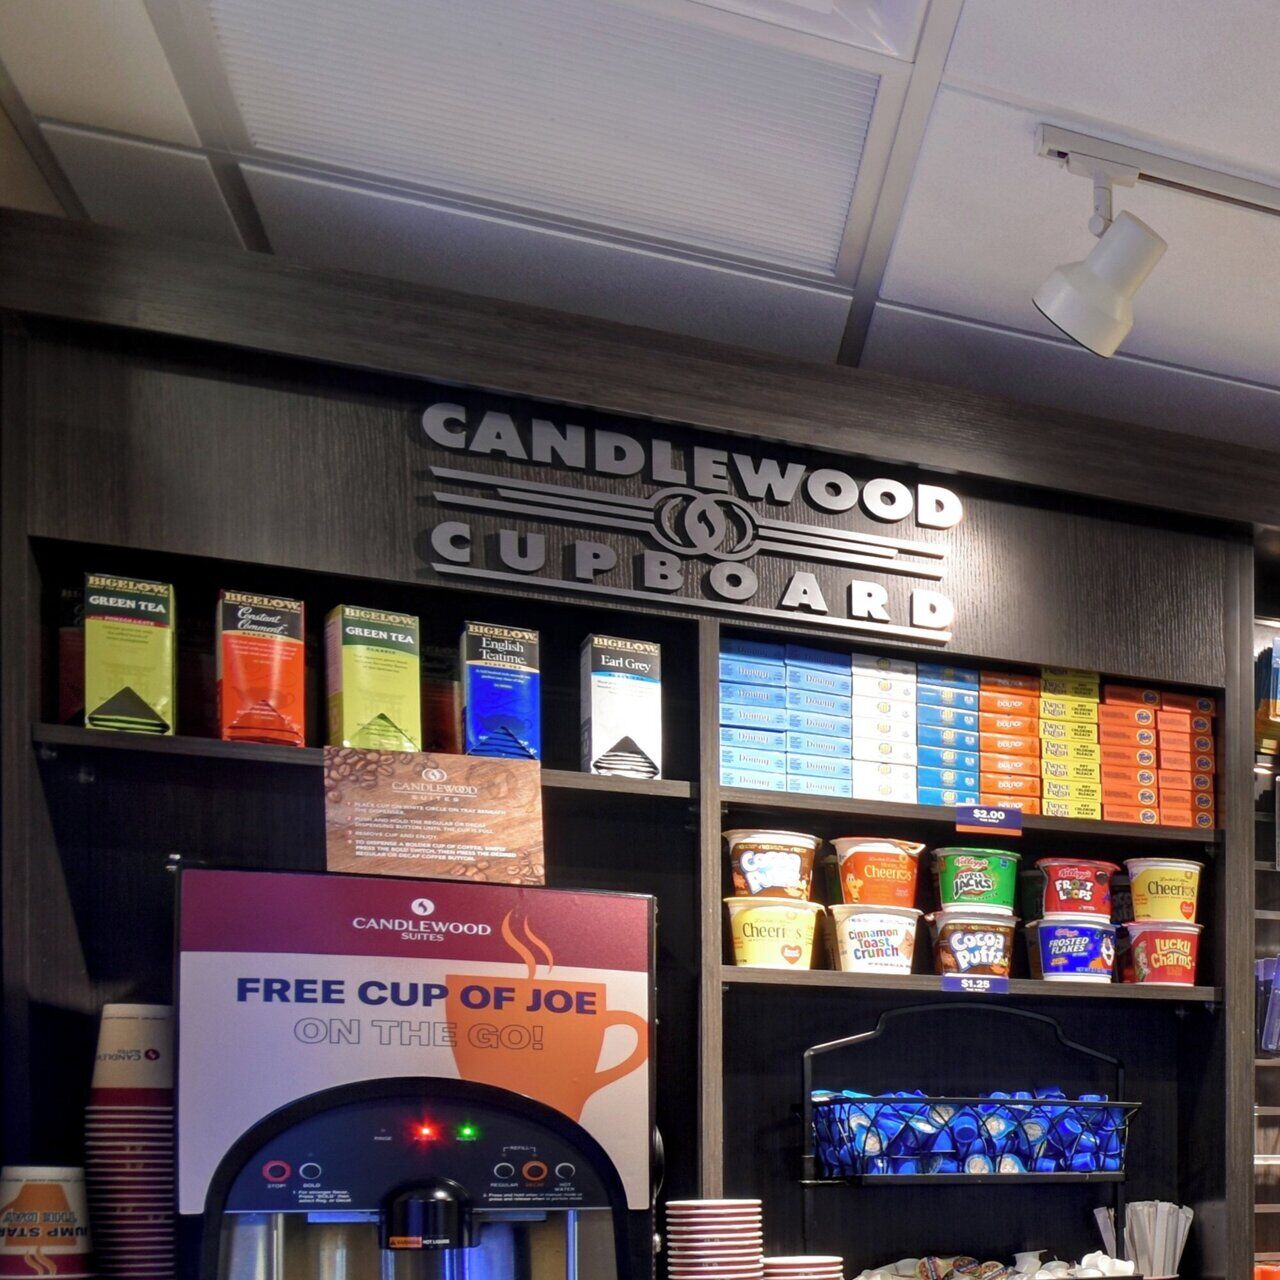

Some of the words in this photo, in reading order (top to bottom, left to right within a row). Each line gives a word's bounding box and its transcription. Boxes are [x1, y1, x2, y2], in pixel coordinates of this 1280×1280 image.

[422, 402, 963, 530] CANDLEWOOD
[430, 521, 955, 629] CUPBOARD
[88, 576, 168, 594] BIGELOW
[89, 595, 136, 609] GREEN
[138, 602, 166, 613] TEA
[224, 592, 301, 609] BIGELOW
[345, 607, 416, 625] BIGELOW
[346, 626, 388, 640] GREEN
[390, 633, 414, 644] TEA
[468, 624, 536, 641] BIGELOW
[482, 638, 524, 653] English
[593, 637, 658, 653] BIGELOW
[479, 649, 524, 664] Teatime
[601, 654, 624, 666] Earl
[626, 659, 651, 672] Grey
[392, 781, 478, 795] CANDLEWOOD
[972, 808, 1005, 821] $2.00
[954, 856, 988, 868] Kellogg's
[864, 864, 912, 882] Cheerios
[959, 871, 984, 880] APPLE
[1058, 867, 1092, 880] Kellogg's
[953, 877, 992, 899] JACKS
[1054, 880, 1094, 891] FROOT
[1147, 880, 1195, 897] Cheerios
[1058, 889, 1093, 901] LOOPS
[352, 916, 492, 936] CANDLEWOOD
[742, 922, 802, 939] Cheeris
[848, 928, 899, 941] Cinnamon
[400, 931, 445, 942] SUITES
[857, 937, 891, 949] Toast
[951, 931, 1004, 951] Cocoa
[1048, 936, 1089, 948] FROSTED
[853, 945, 899, 960] Crunch
[1051, 944, 1085, 955] FLAKES
[1155, 938, 1191, 956] Lucky
[956, 945, 1005, 970] Puffs
[1151, 953, 1193, 969] Charms
[961, 979, 990, 989] $1.25
[237, 977, 345, 1004] FREE
[358, 980, 449, 1008] CUP
[460, 984, 516, 1010] OF
[526, 988, 597, 1015] JOE
[293, 1017, 361, 1045] ON
[371, 1019, 458, 1047] THE
[467, 1022, 545, 1051] GO!
